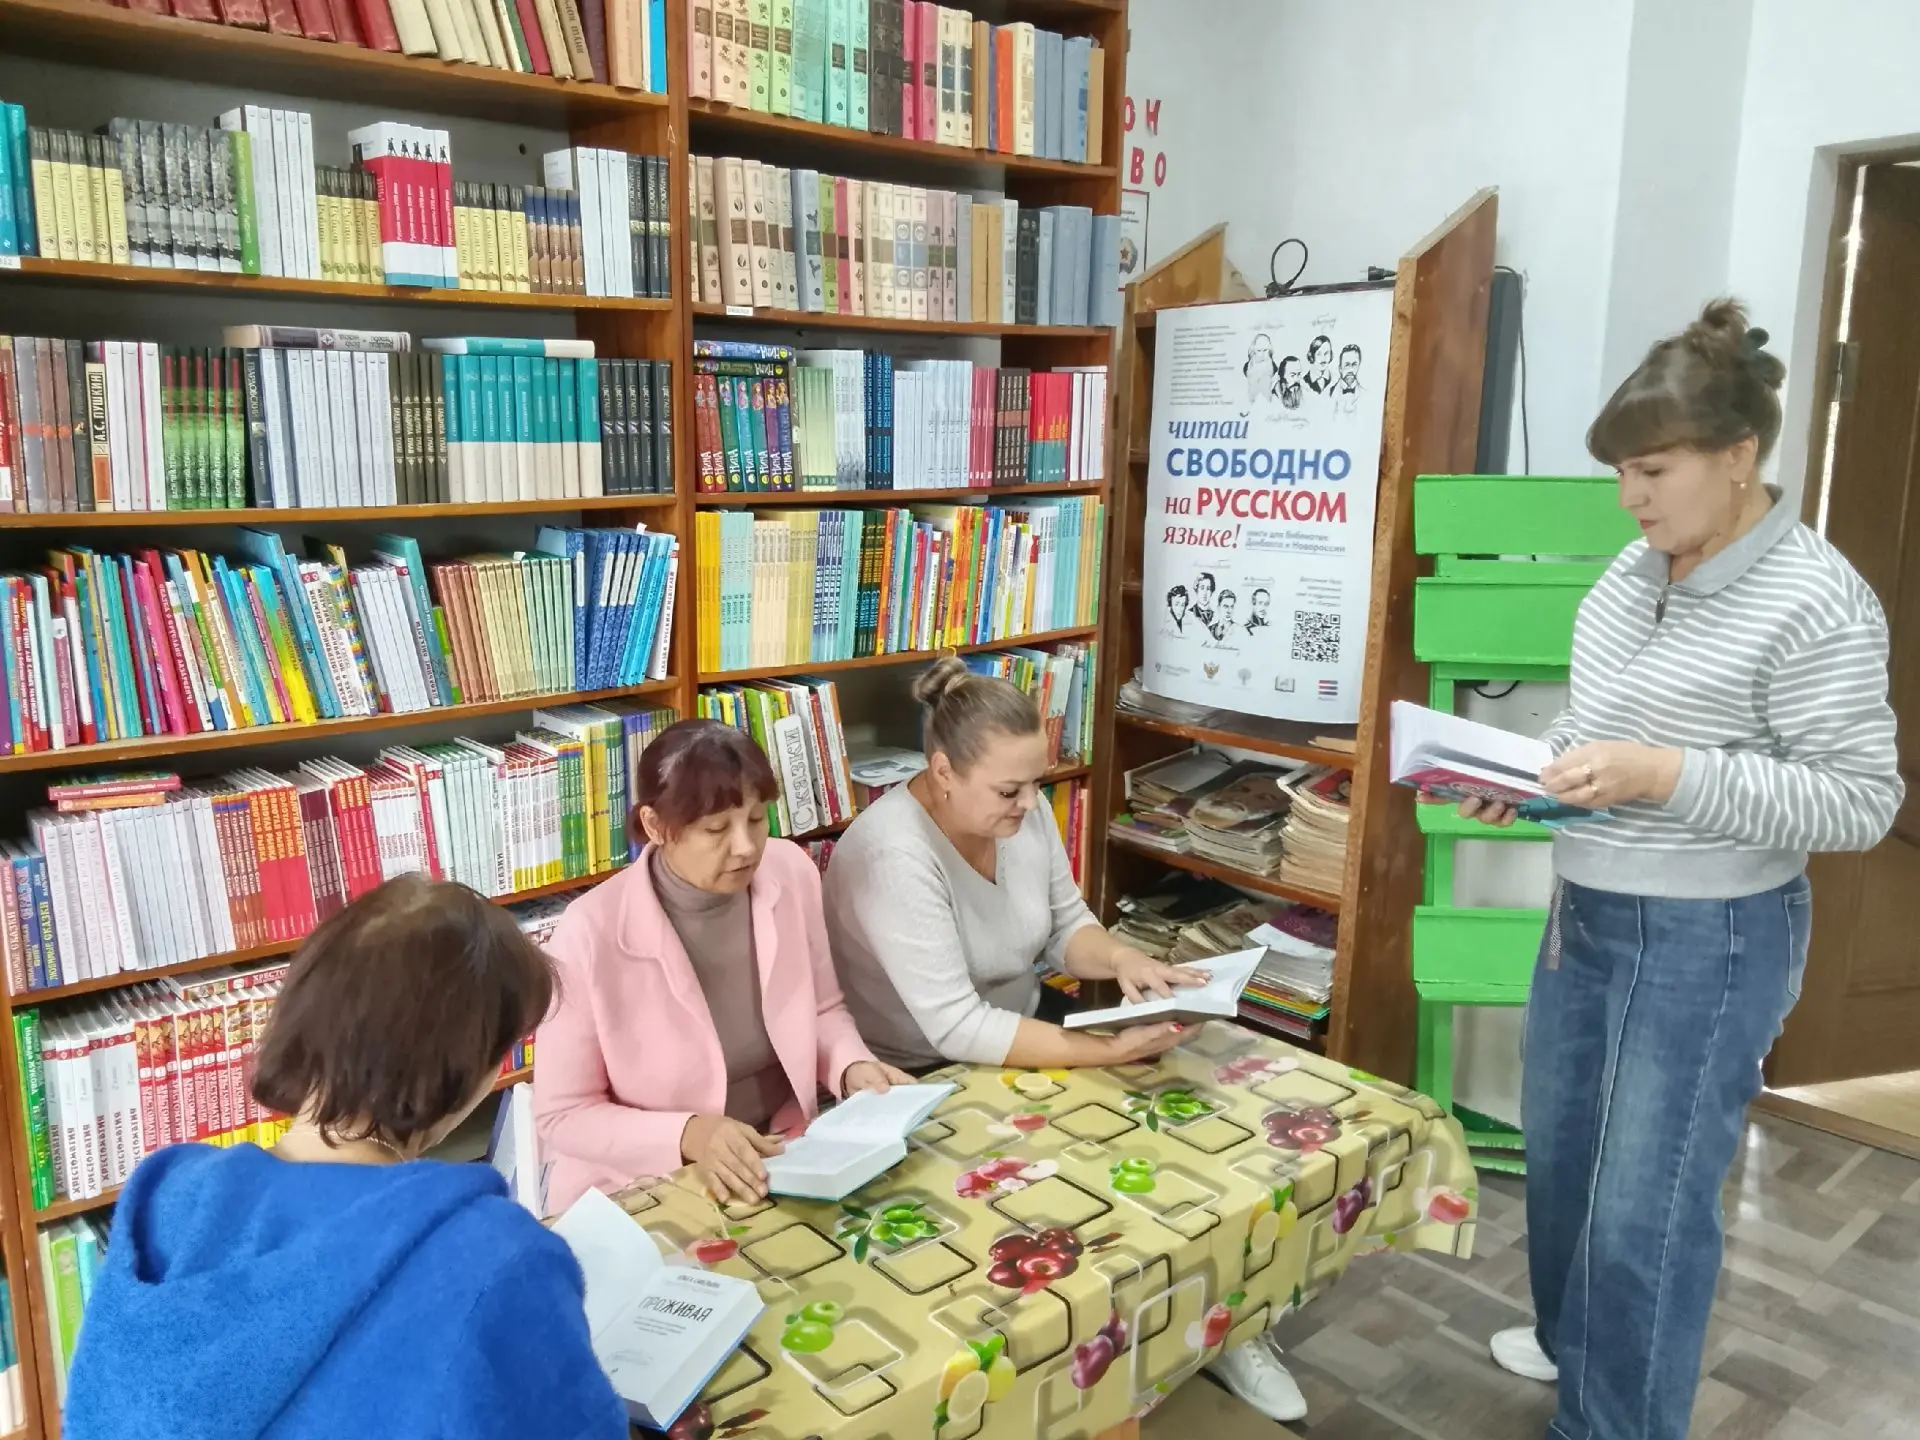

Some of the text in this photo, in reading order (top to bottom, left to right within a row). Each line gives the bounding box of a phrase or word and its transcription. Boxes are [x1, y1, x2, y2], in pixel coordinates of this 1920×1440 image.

[90, 374, 105, 419] ПУШКИН
[1168, 411, 1250, 439] читай
[1166, 448, 1351, 486] СВОБОДНО
[1165, 487, 1347, 523] на РУССКОМ
[1163, 524, 1241, 549] языке!
[497, 852, 506, 890] СКАЗКИ
[40, 902, 53, 940] СКАЗКИ
[638, 1296, 714, 1323] ПРОЖИВАЯ
